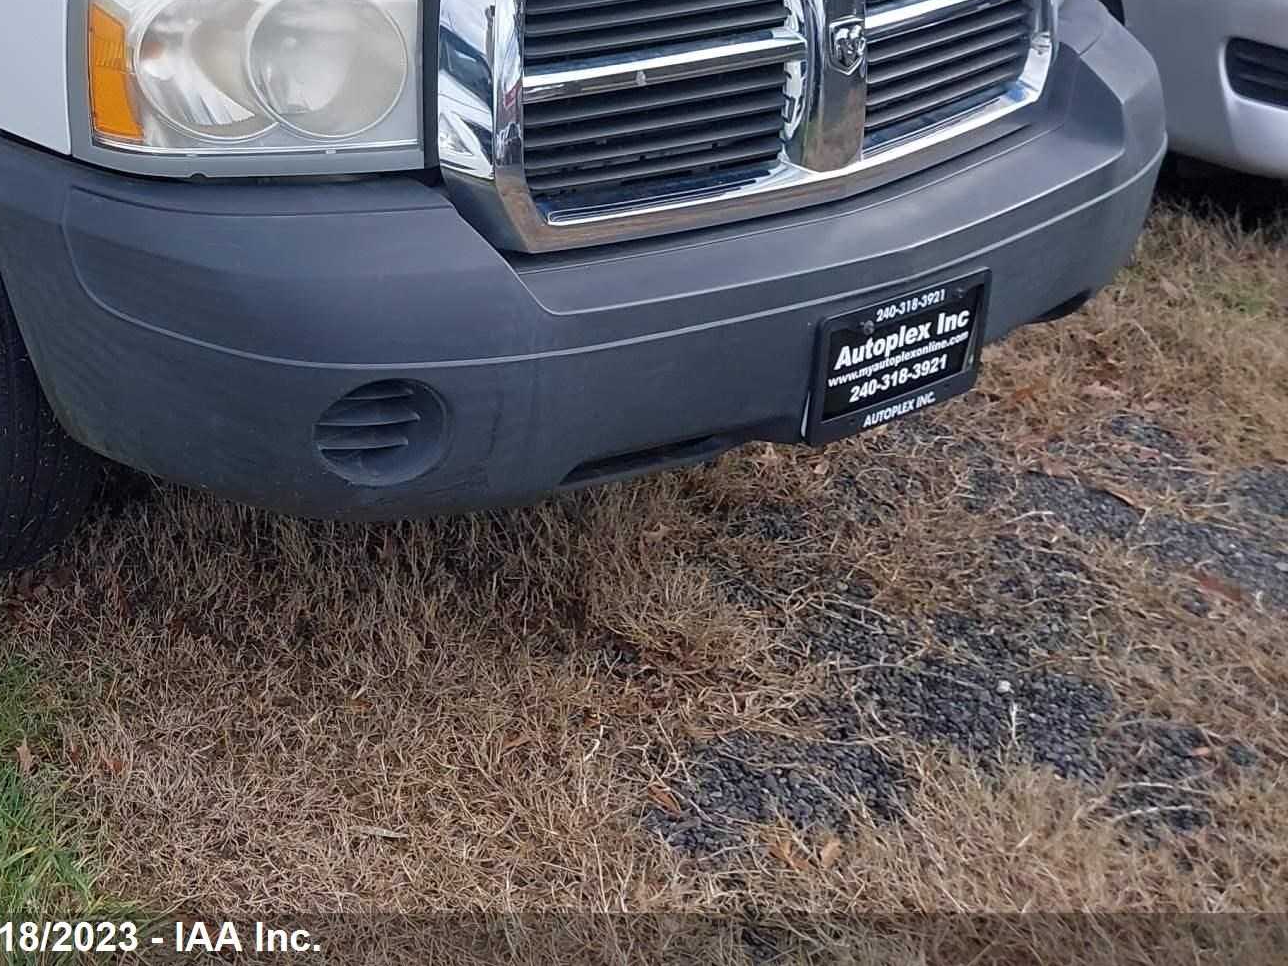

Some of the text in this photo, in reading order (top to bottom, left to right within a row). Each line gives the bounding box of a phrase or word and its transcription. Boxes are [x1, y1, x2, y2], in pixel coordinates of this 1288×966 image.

[876, 289, 945, 322] 240-318-3921
[828, 331, 969, 387] www.myautoplexonline.com
[834, 310, 970, 370] Autoplex Inc
[849, 354, 947, 402] 240-318-3921
[863, 399, 915, 428] AUTOPLEX
